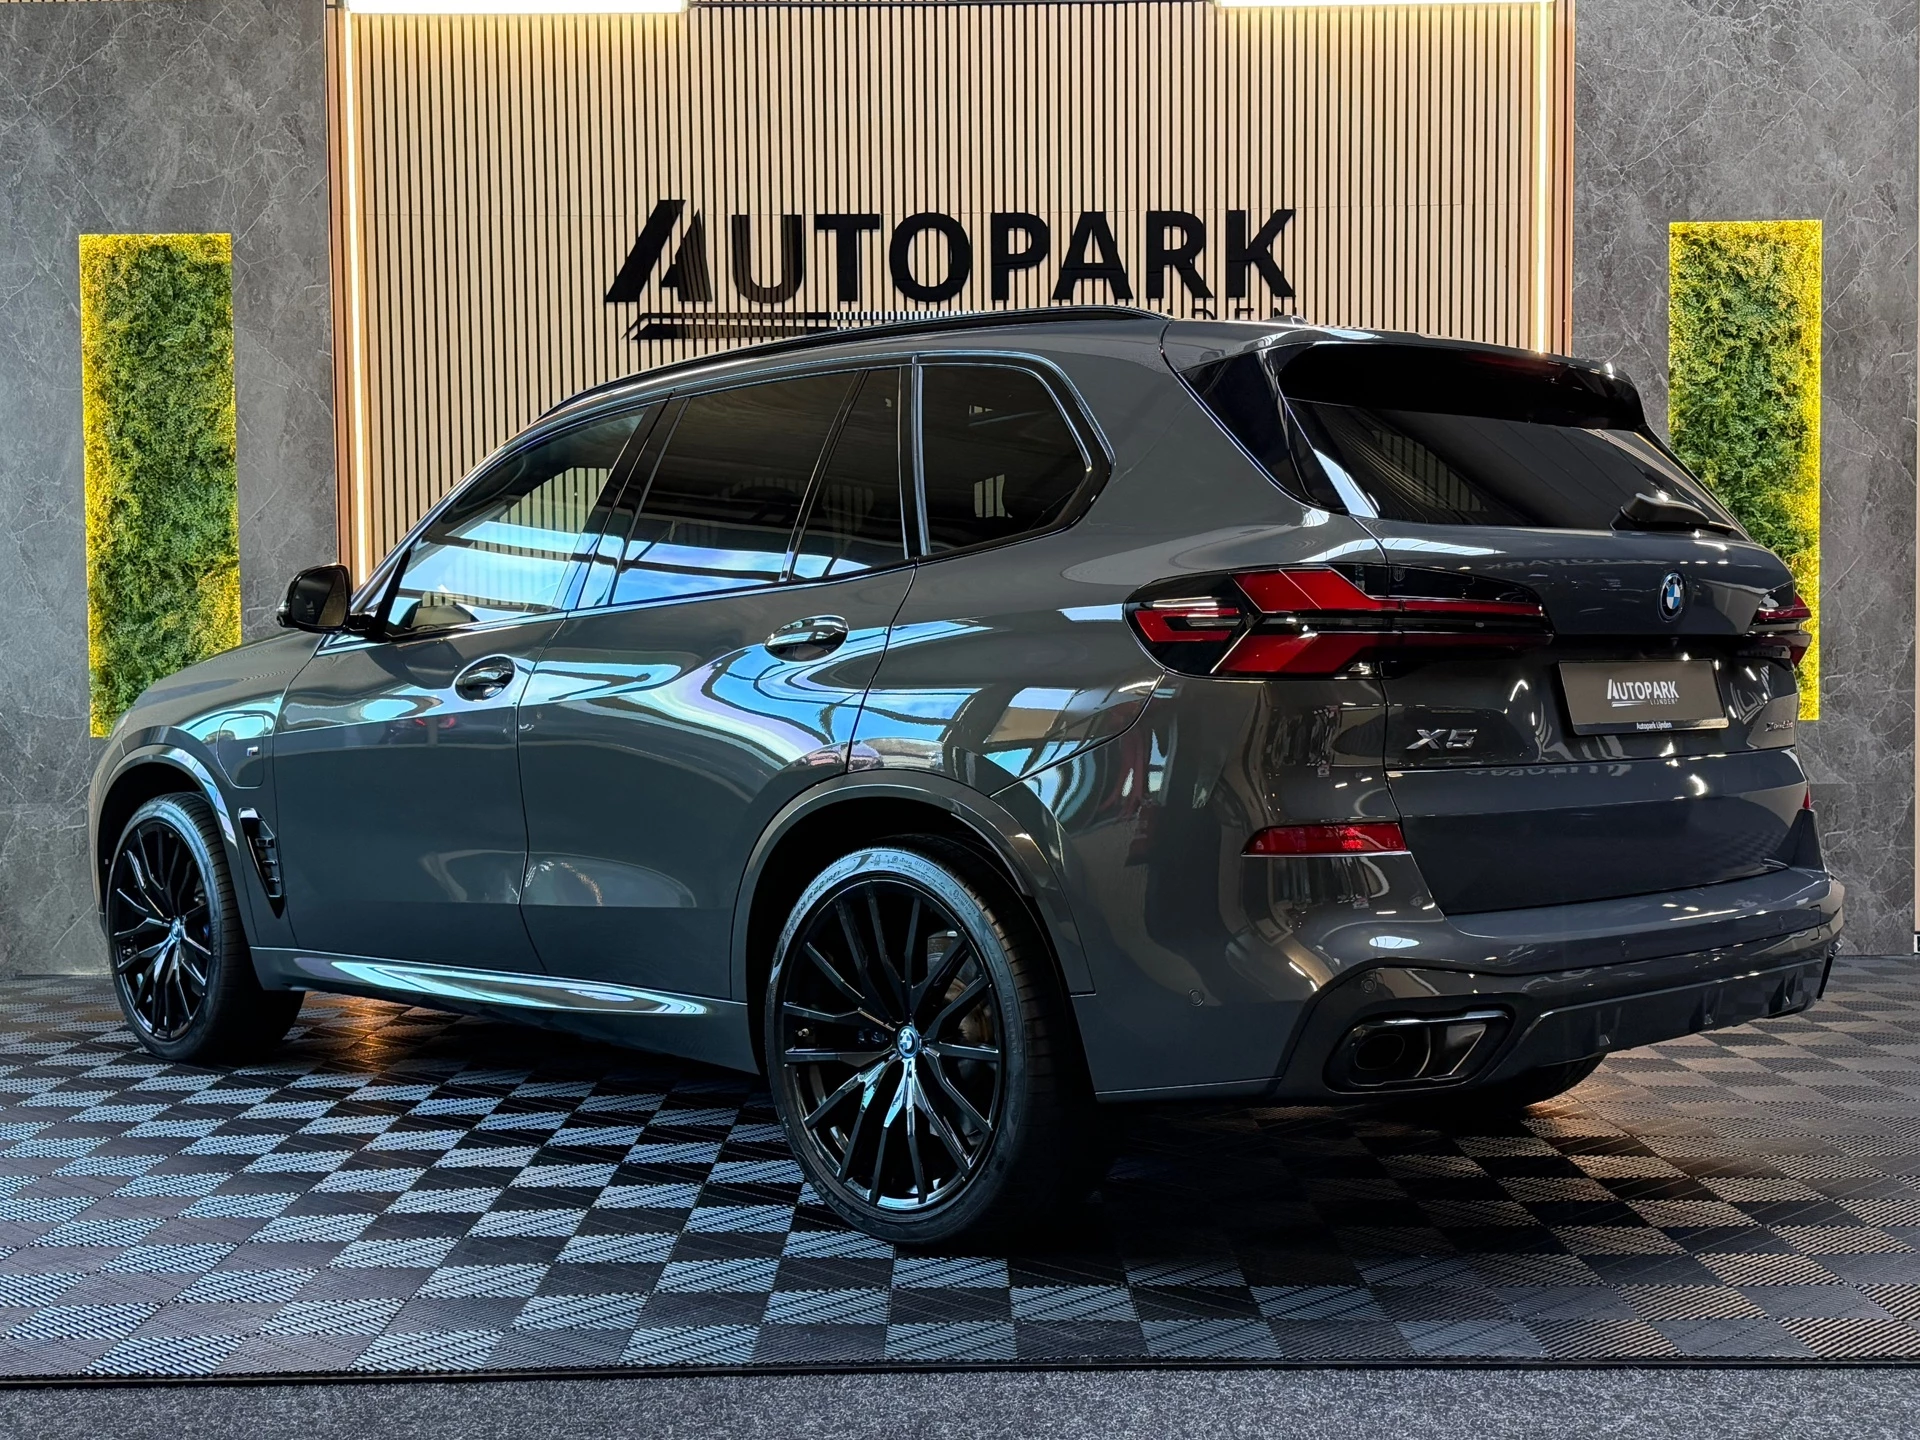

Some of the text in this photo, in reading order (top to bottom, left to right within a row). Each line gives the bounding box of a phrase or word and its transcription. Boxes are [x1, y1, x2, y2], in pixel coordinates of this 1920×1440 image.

[604, 198, 1297, 303] AUTOPARK
[1607, 678, 1679, 700] AUTOPARK
[1405, 728, 1478, 749] X5
